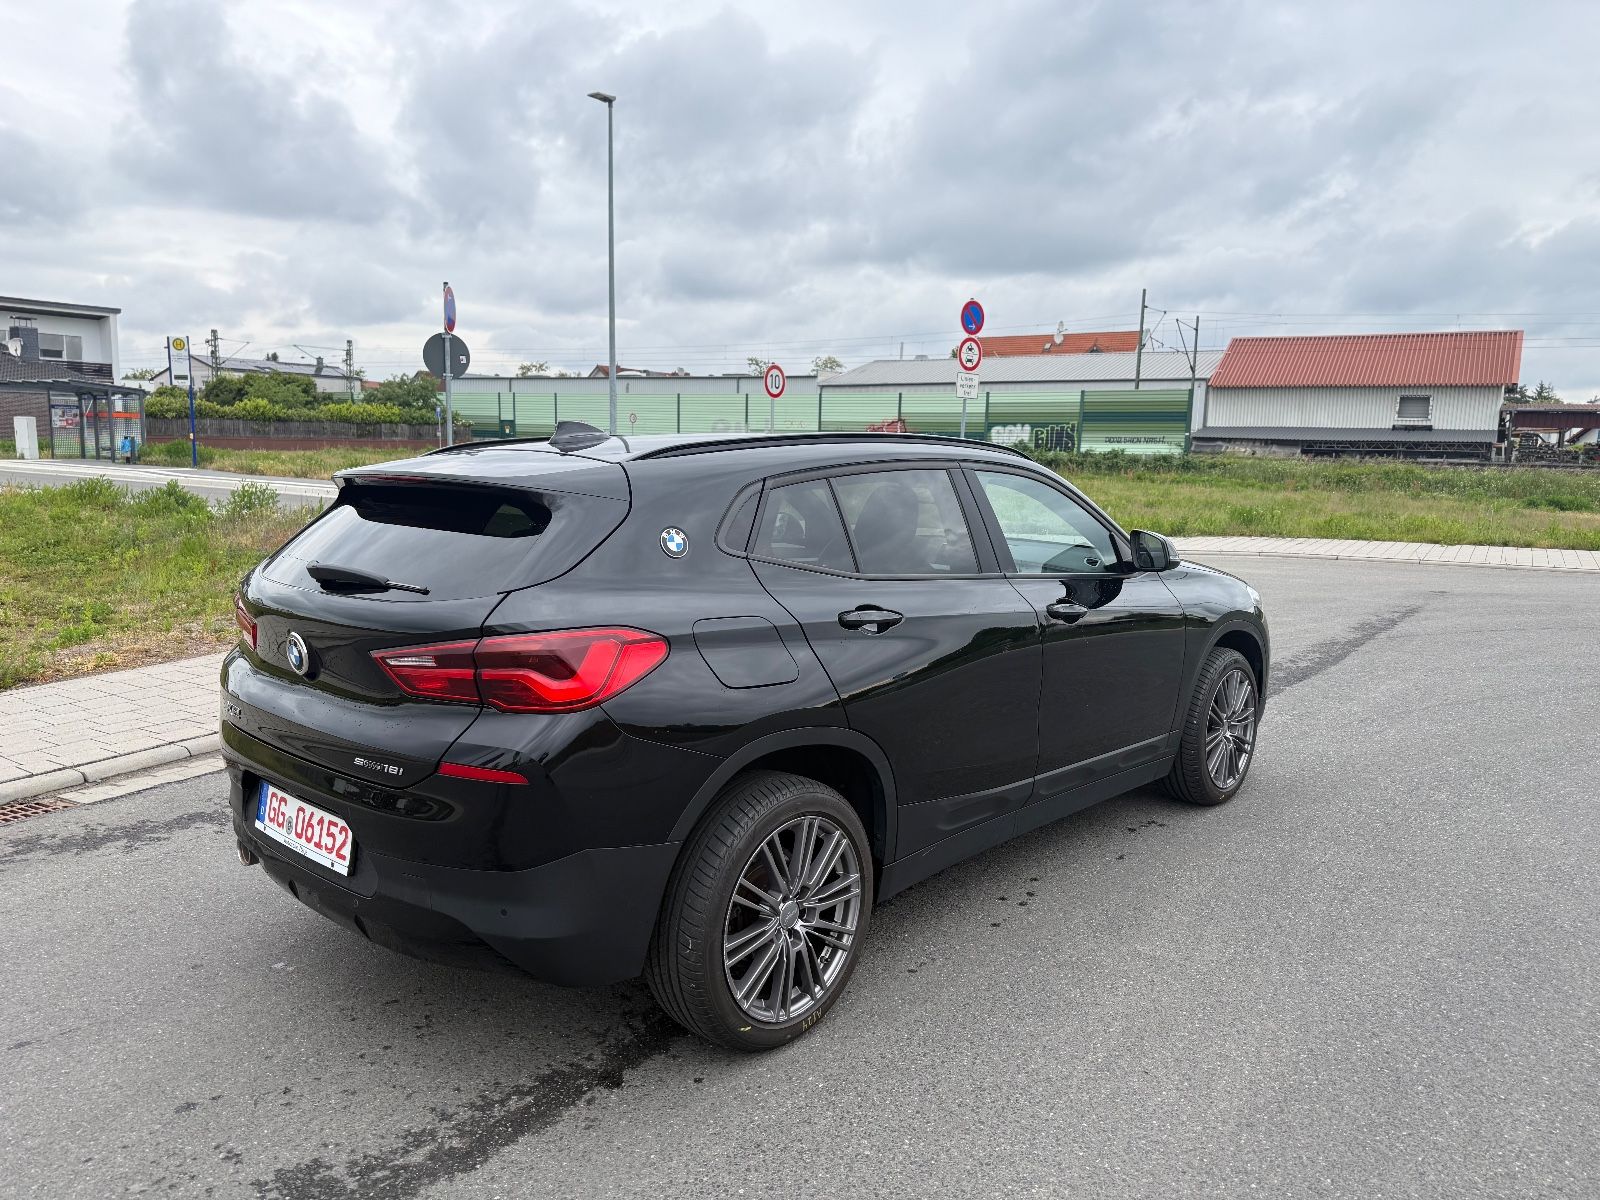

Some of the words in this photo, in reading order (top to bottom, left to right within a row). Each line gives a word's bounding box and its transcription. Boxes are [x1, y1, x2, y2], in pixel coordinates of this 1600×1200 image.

[769, 374, 780, 389] 10
[267, 791, 288, 830] GG
[294, 805, 349, 861] 06152
